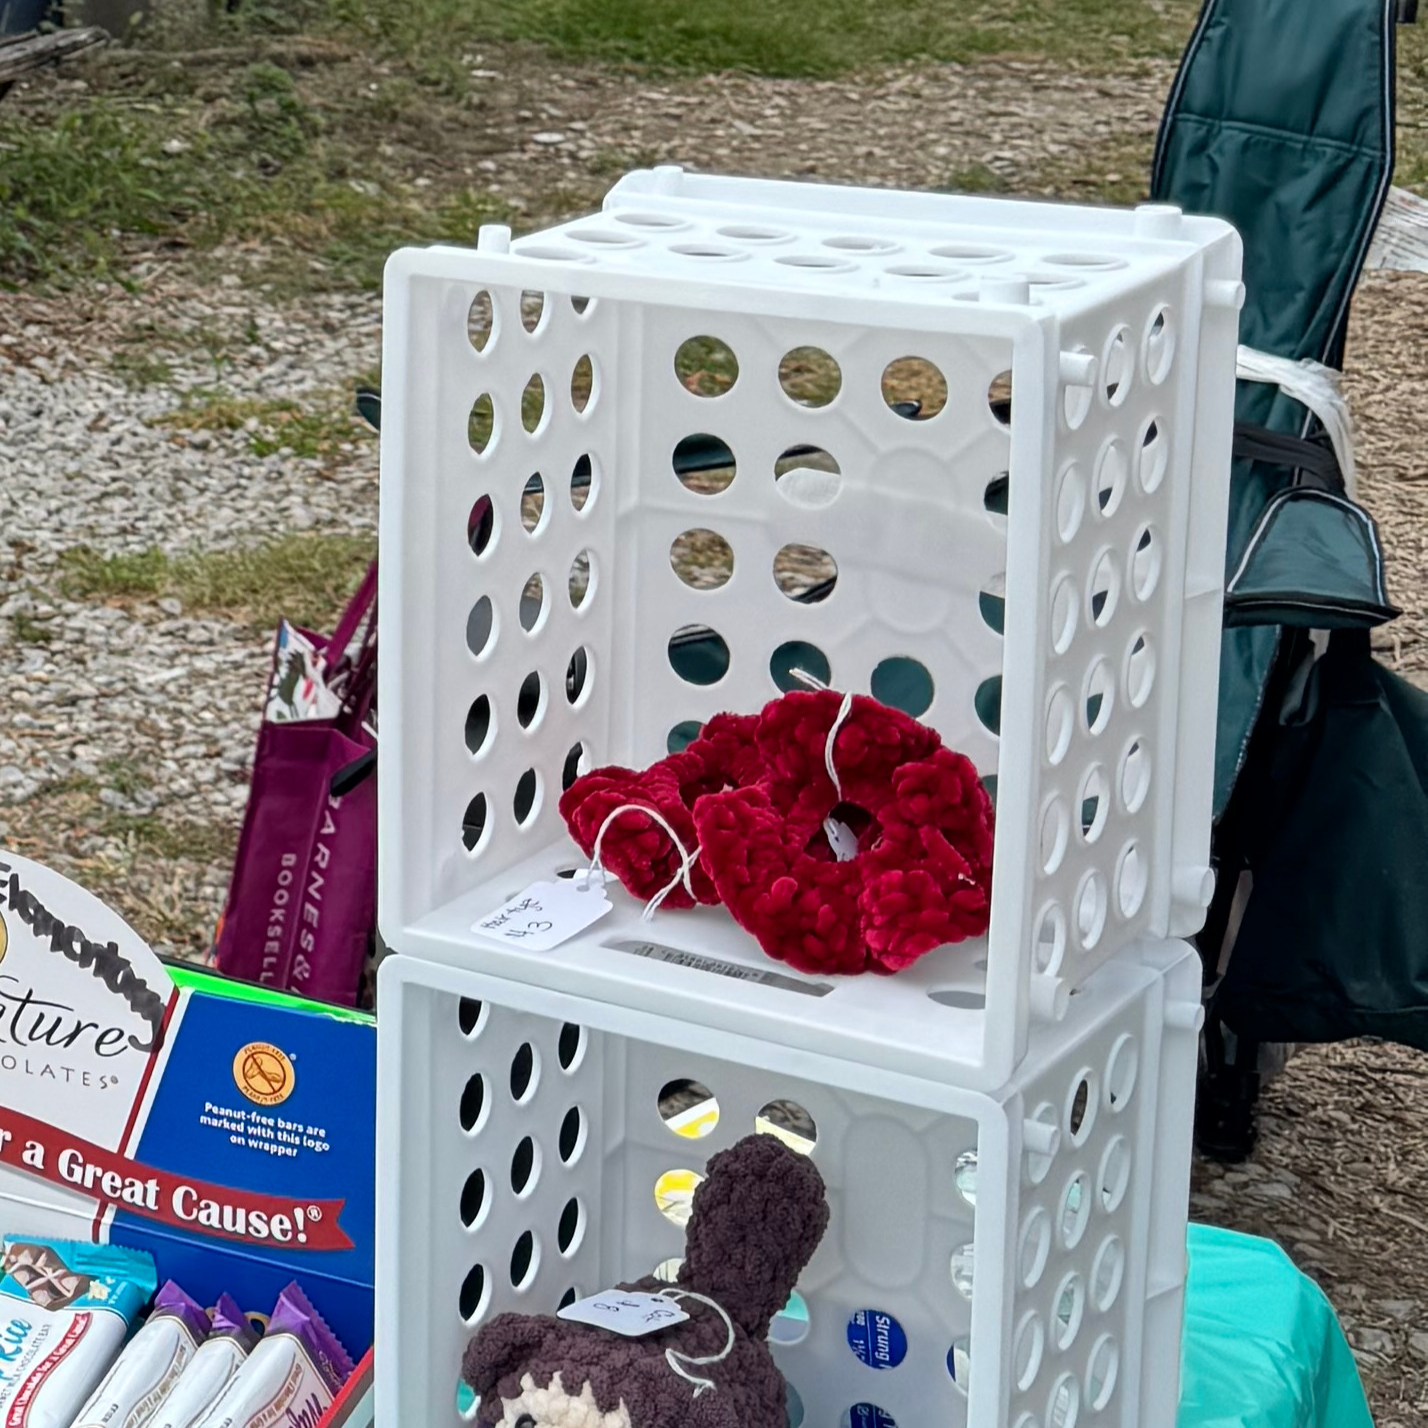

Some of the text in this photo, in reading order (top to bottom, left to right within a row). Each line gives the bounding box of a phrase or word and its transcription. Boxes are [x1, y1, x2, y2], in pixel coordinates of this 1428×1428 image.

[200, 1115, 331, 1152] marked with this logo
[205, 1102, 326, 1138] Peanut-free bars are
[230, 1134, 298, 1157] on wrapper
[22, 1140, 44, 1170] a
[57, 1148, 160, 1211] Great
[875, 1315, 891, 1361] Strung
